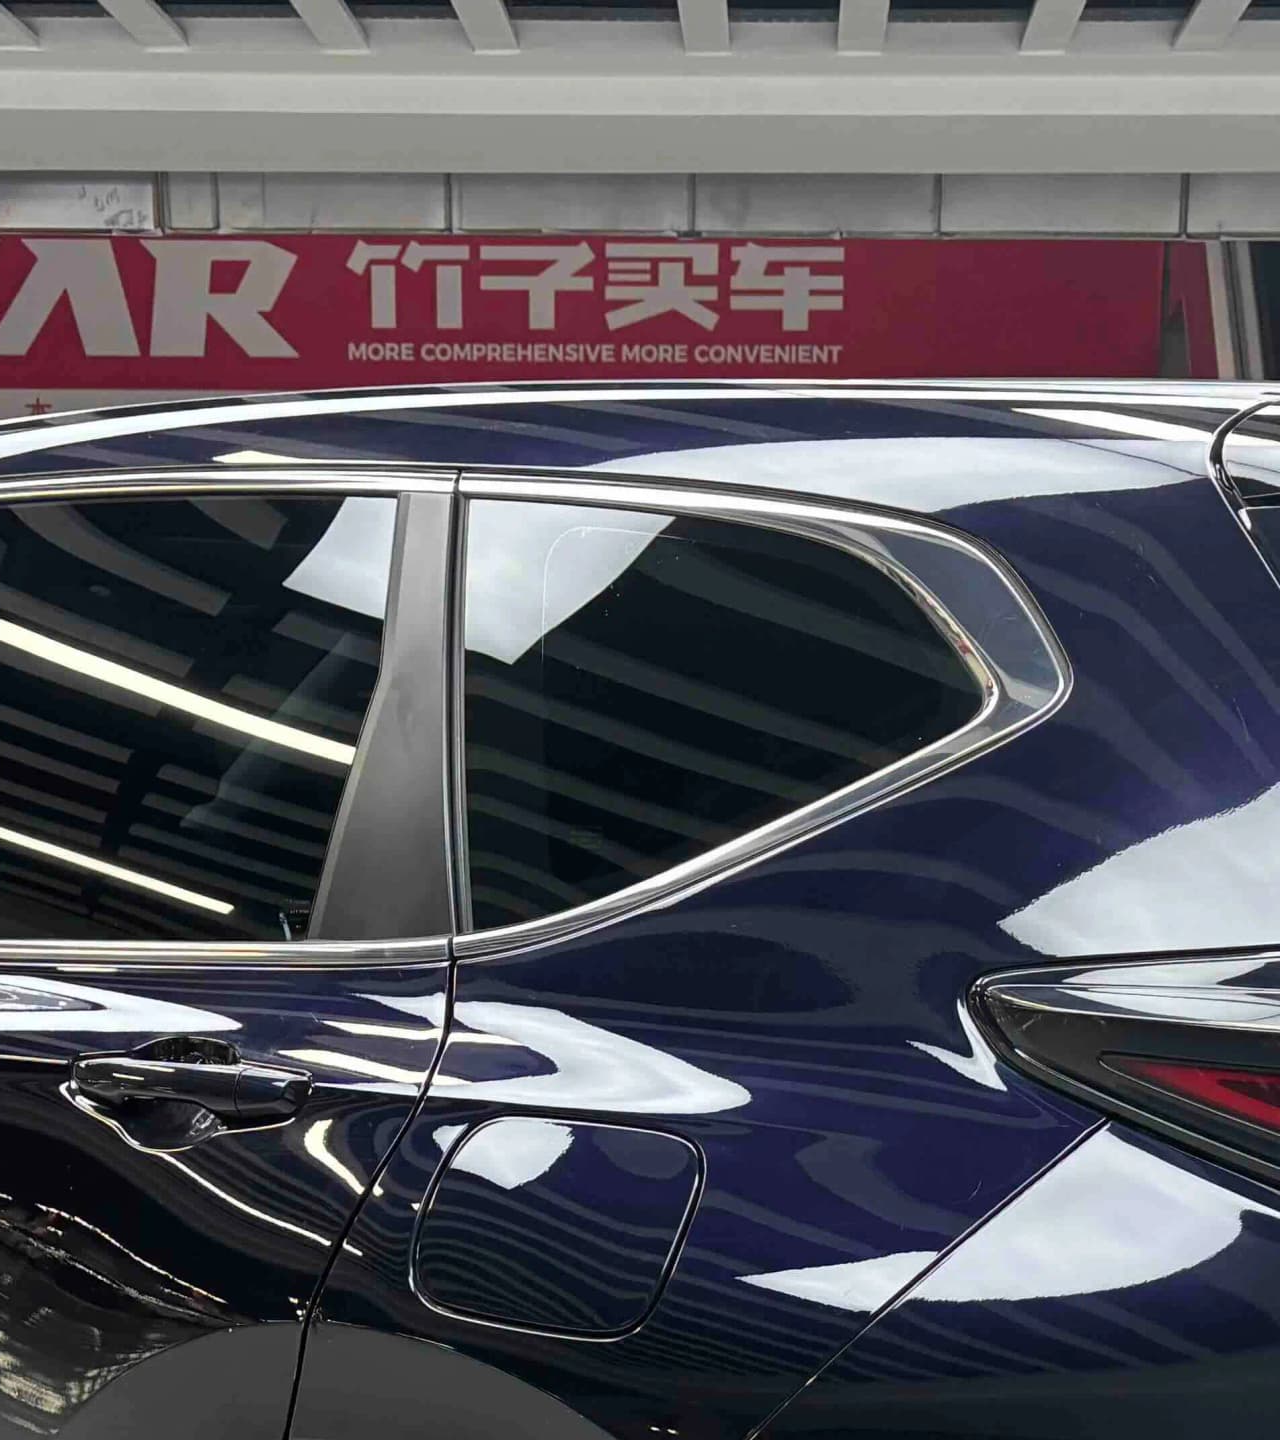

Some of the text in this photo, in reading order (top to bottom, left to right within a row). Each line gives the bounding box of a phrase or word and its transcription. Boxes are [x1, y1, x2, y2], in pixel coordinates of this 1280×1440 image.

[346, 239, 844, 331] 竹子买车
[348, 343, 842, 364] MORE COMPREHENSIVE MORE CONVENIENT
